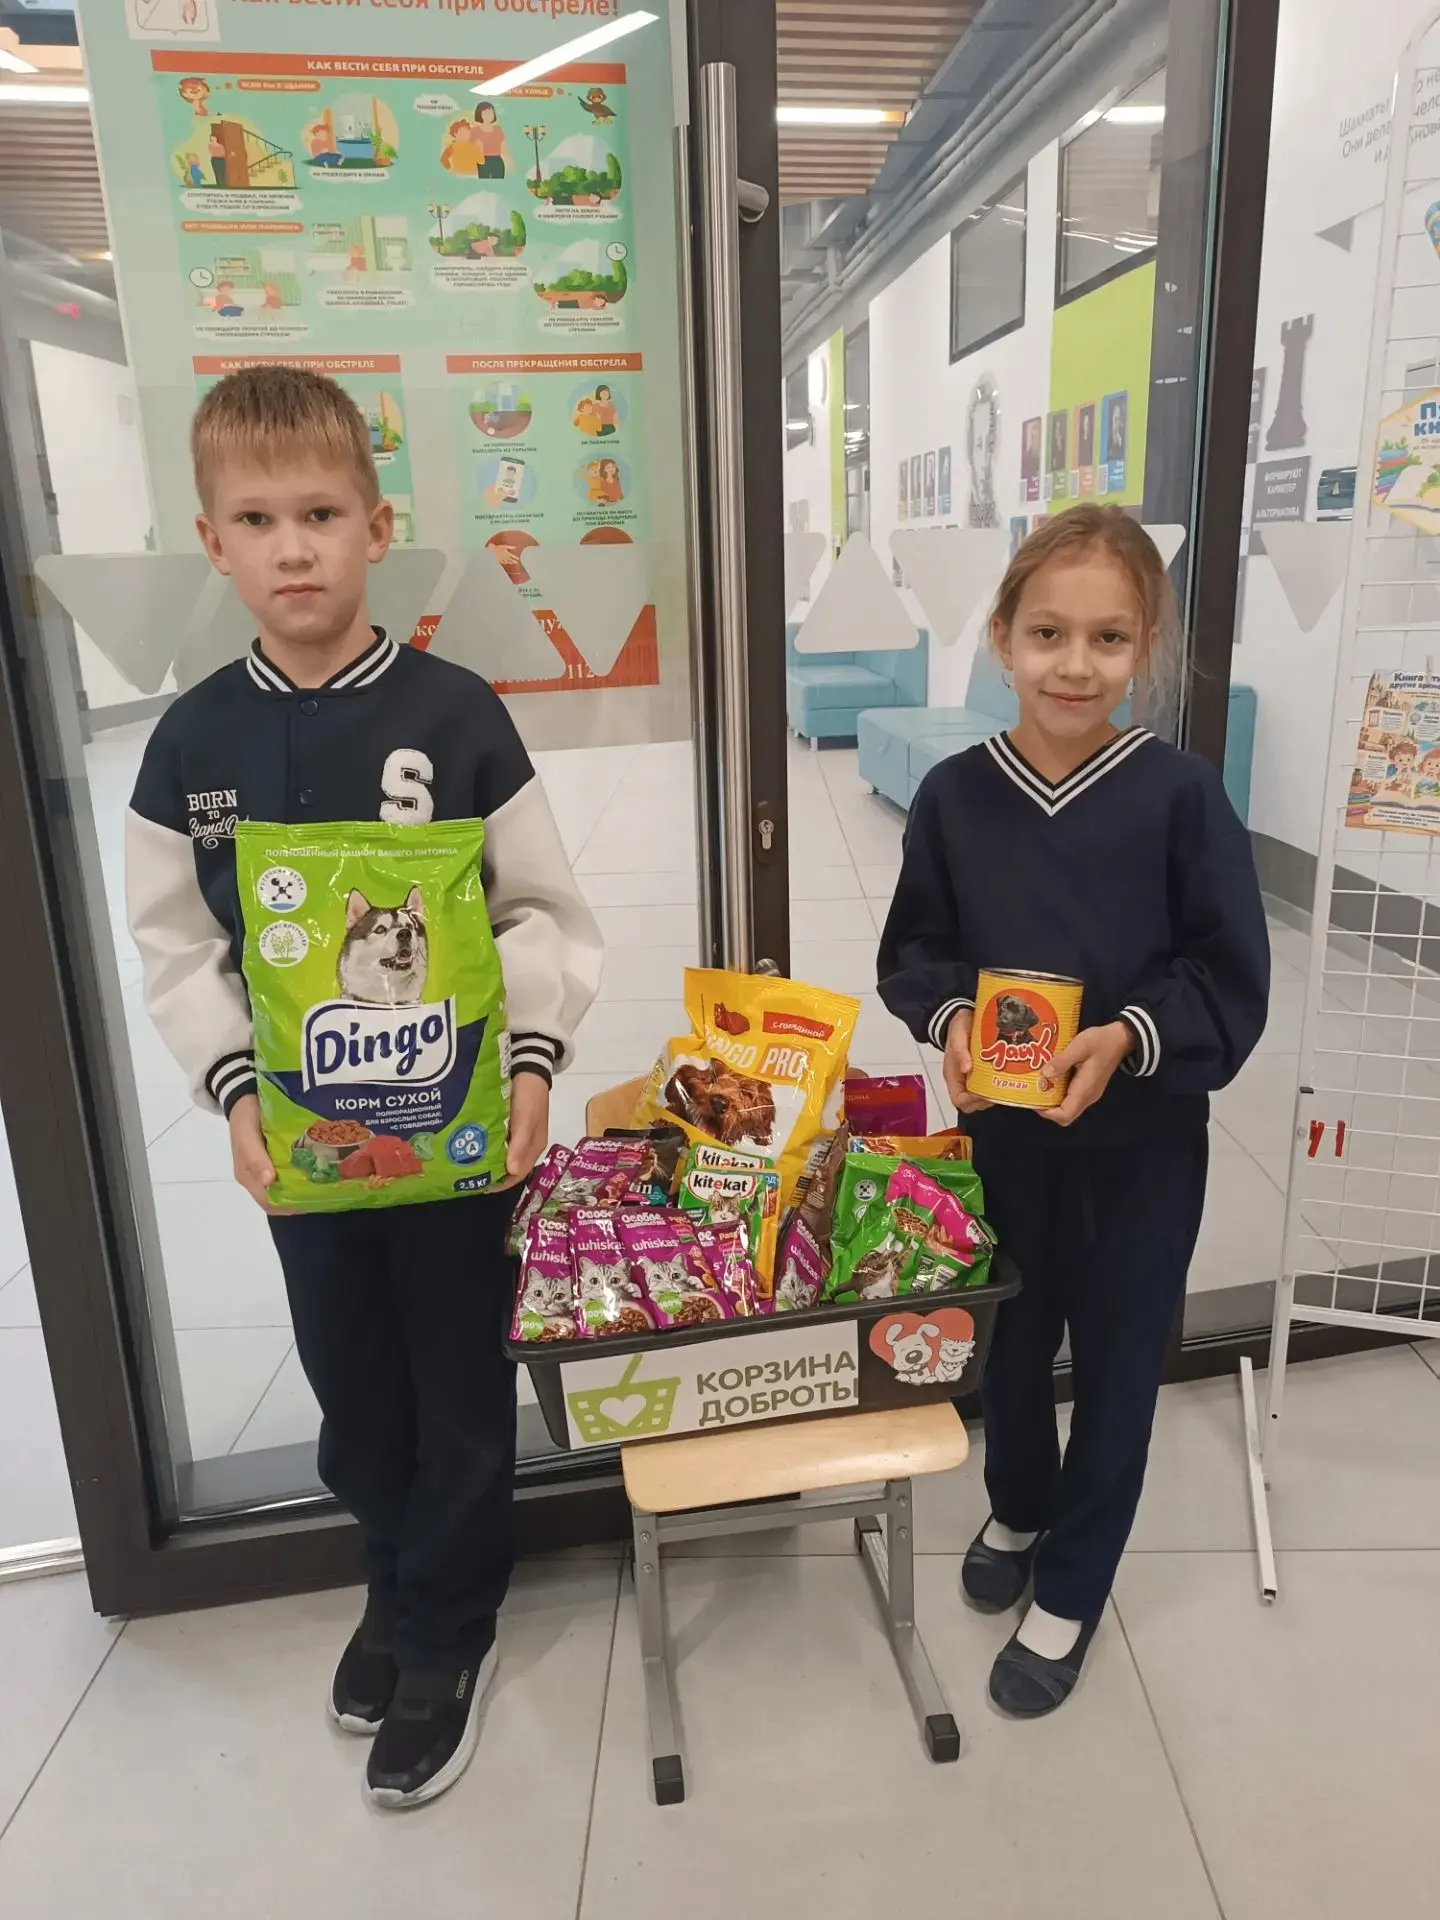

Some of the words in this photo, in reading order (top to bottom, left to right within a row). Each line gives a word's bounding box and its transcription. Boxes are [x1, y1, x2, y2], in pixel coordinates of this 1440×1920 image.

[307, 60, 332, 71] КАК
[334, 61, 369, 72] ВЕСТИ
[372, 62, 400, 73] СЕБЯ
[402, 63, 426, 73] ПРИ
[428, 63, 484, 75] ОБСТРЕЛЕ
[221, 360, 241, 370] КАК
[302, 360, 326, 369] ПРИ
[327, 359, 375, 369] ОБСТРЕЛЕ
[472, 360, 504, 369] ПОСЛЕ
[506, 359, 578, 369] ПРЕКРАЩЕНИЯ
[580, 358, 628, 368] ОБСТРЕЛА
[1394, 672, 1424, 682] Книга
[379, 748, 434, 826] S
[186, 789, 237, 812] BORN
[207, 810, 220, 820] TO
[189, 817, 228, 840] Stand
[265, 848, 338, 858] ПОЛНОЦЕННЫЙ
[377, 848, 412, 858] ВАШЕГО
[414, 847, 459, 857] ПИТОМЦА
[315, 1014, 444, 1076] Dingo
[981, 1028, 1053, 1071] Лайк
[760, 1047, 806, 1079] PRO
[993, 1077, 1029, 1091] Гурман
[335, 1098, 381, 1111] КОРМ
[386, 1088, 442, 1108] СУХОЙ
[375, 1103, 442, 1118] ПОЛНОРАЦИОННЫЙ
[365, 1118, 379, 1127] ДЛЯ
[380, 1115, 417, 1125] ВЗРОСЛЫХ
[571, 1156, 610, 1173] whiskas
[459, 1181, 476, 1191] 2,5
[477, 1178, 488, 1188] кг
[693, 1173, 748, 1196] kitekat
[538, 1218, 569, 1232] Особ
[621, 1212, 664, 1224] Особое
[632, 1238, 676, 1252] whiskas
[531, 1250, 572, 1265] whisk
[520, 1319, 544, 1331] 100%
[696, 1350, 856, 1396] КОРЗИНА
[698, 1377, 858, 1428] ДОБРОТЫ
